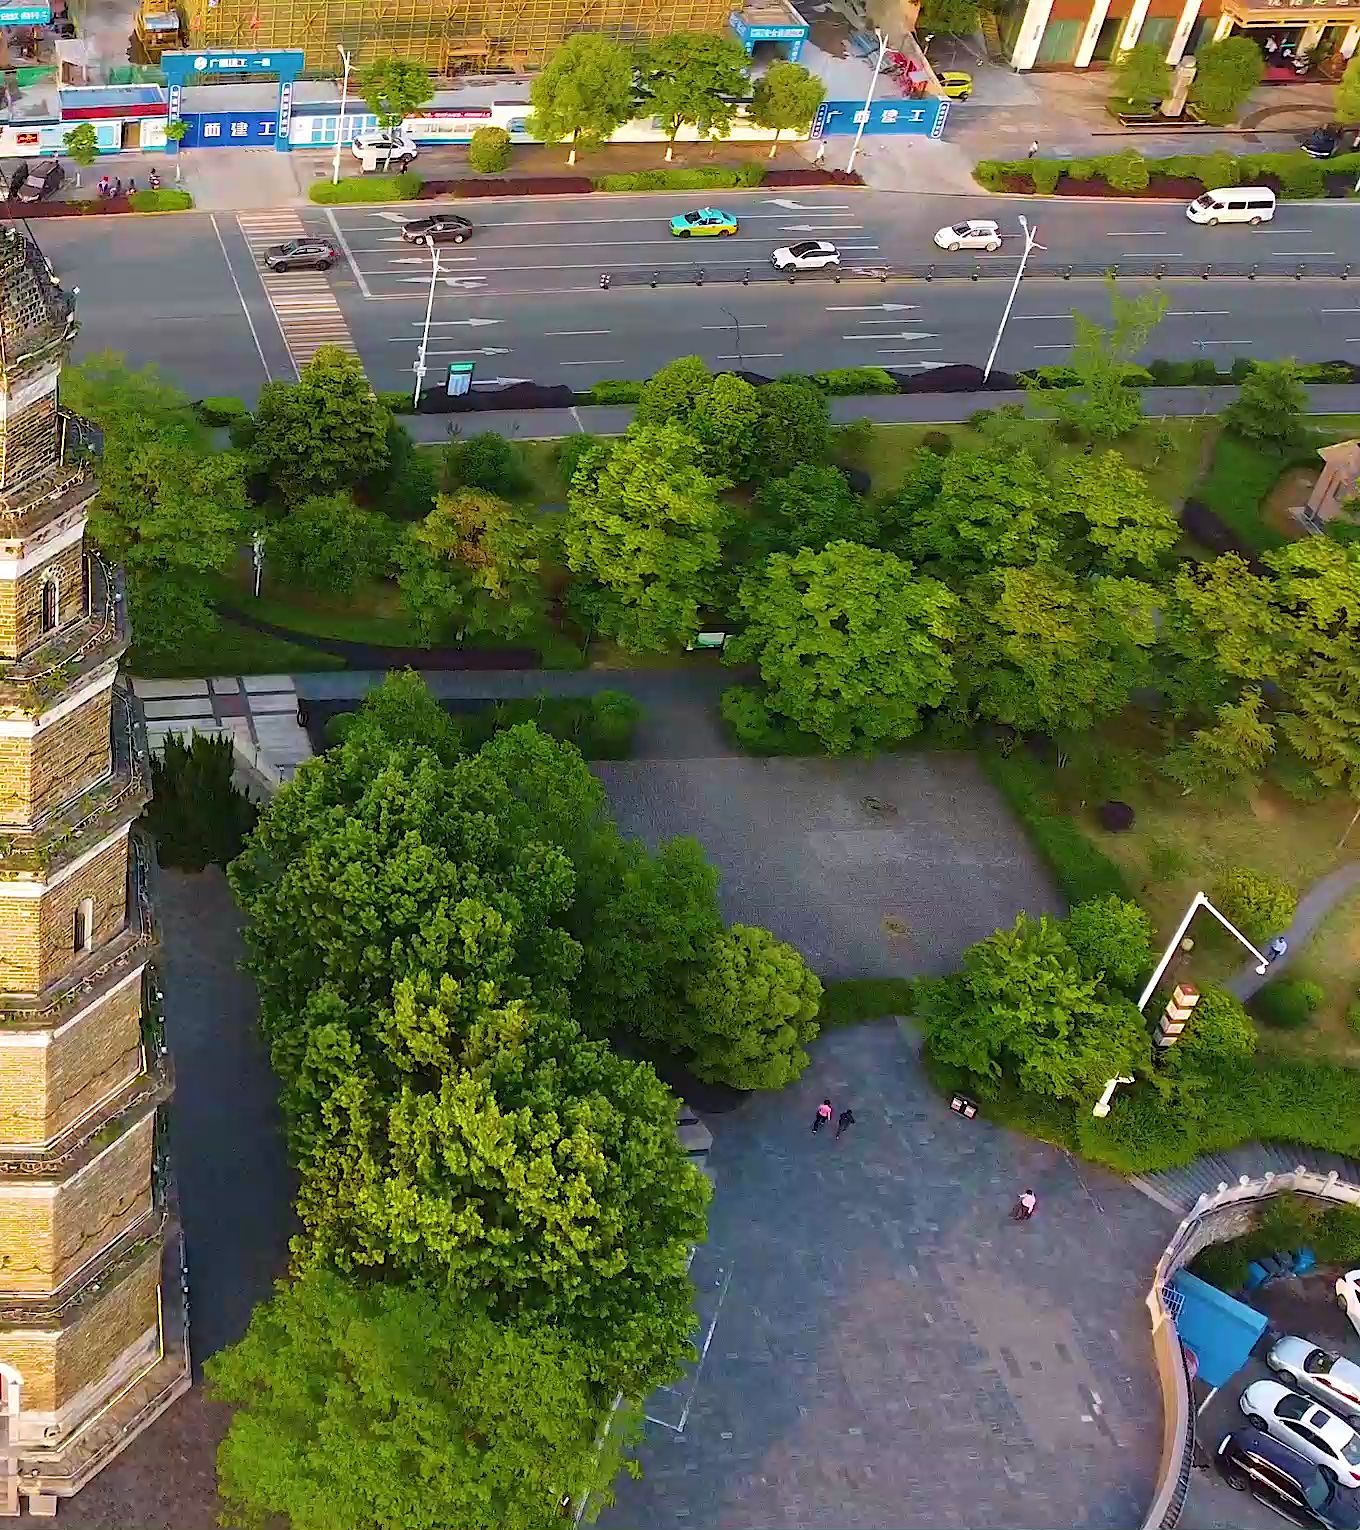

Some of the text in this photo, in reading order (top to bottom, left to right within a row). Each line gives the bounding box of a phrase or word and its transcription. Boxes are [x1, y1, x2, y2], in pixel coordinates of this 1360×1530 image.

[825, 109, 926, 124] 广西建工
[188, 121, 277, 137] 西建工
